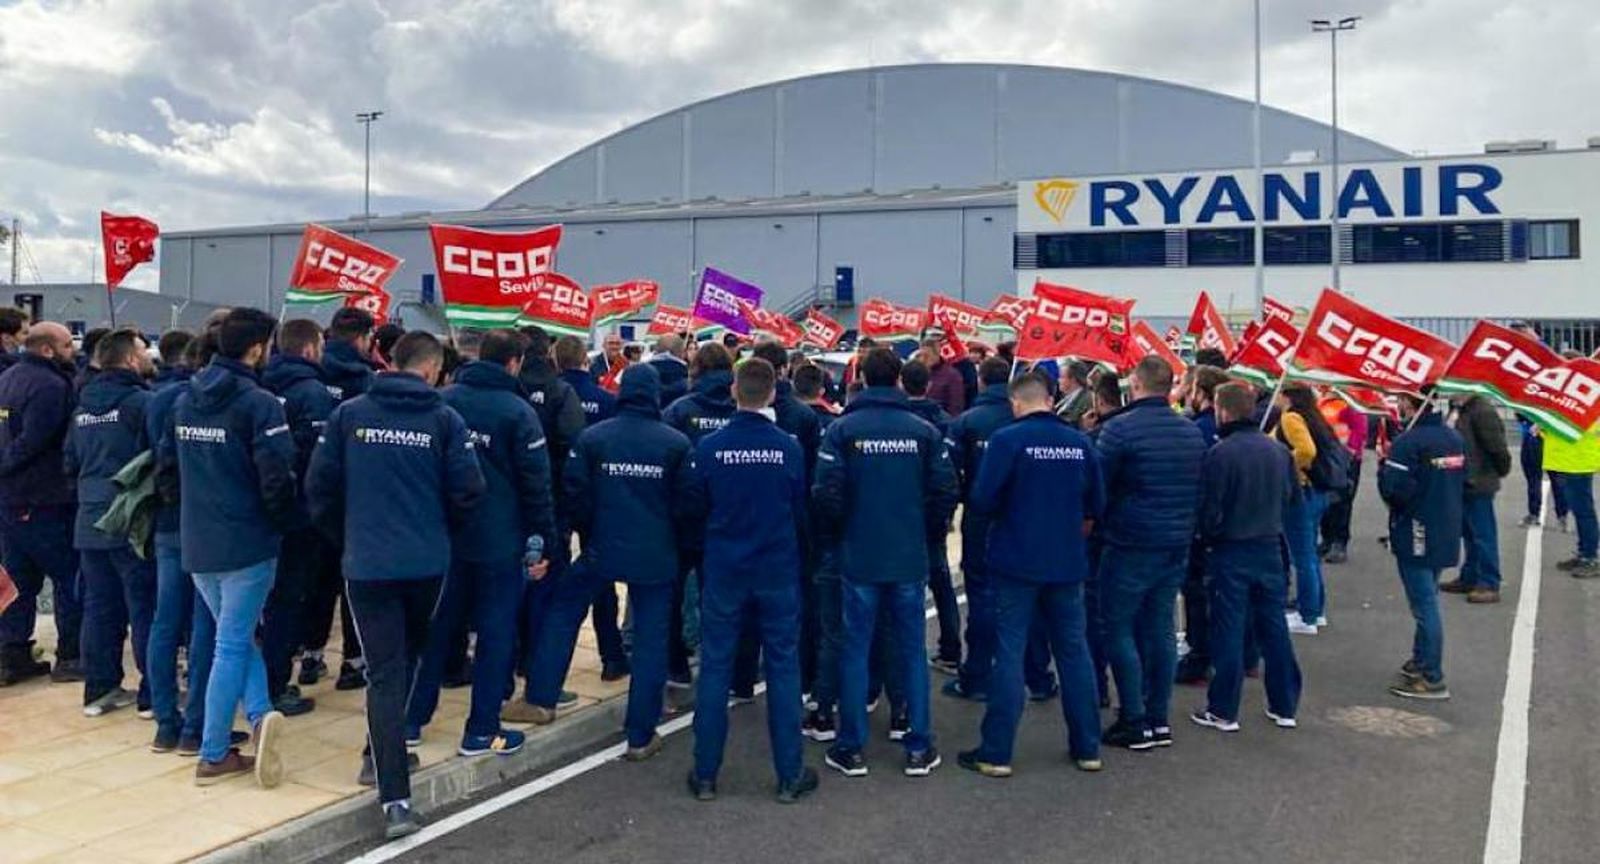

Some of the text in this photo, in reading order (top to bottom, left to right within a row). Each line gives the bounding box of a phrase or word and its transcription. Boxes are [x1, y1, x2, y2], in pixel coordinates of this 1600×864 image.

[1089, 164, 1504, 226] RYANAIR
[306, 241, 386, 284] CCOO
[443, 245, 551, 277] CCOO
[1317, 311, 1433, 384] CCOO
[1474, 338, 1600, 407] CCOO
[365, 429, 432, 443] RYANAIR
[863, 440, 918, 450] RYANAIR
[609, 462, 664, 474] RYANAIR
[723, 450, 784, 460] RYANAIR
